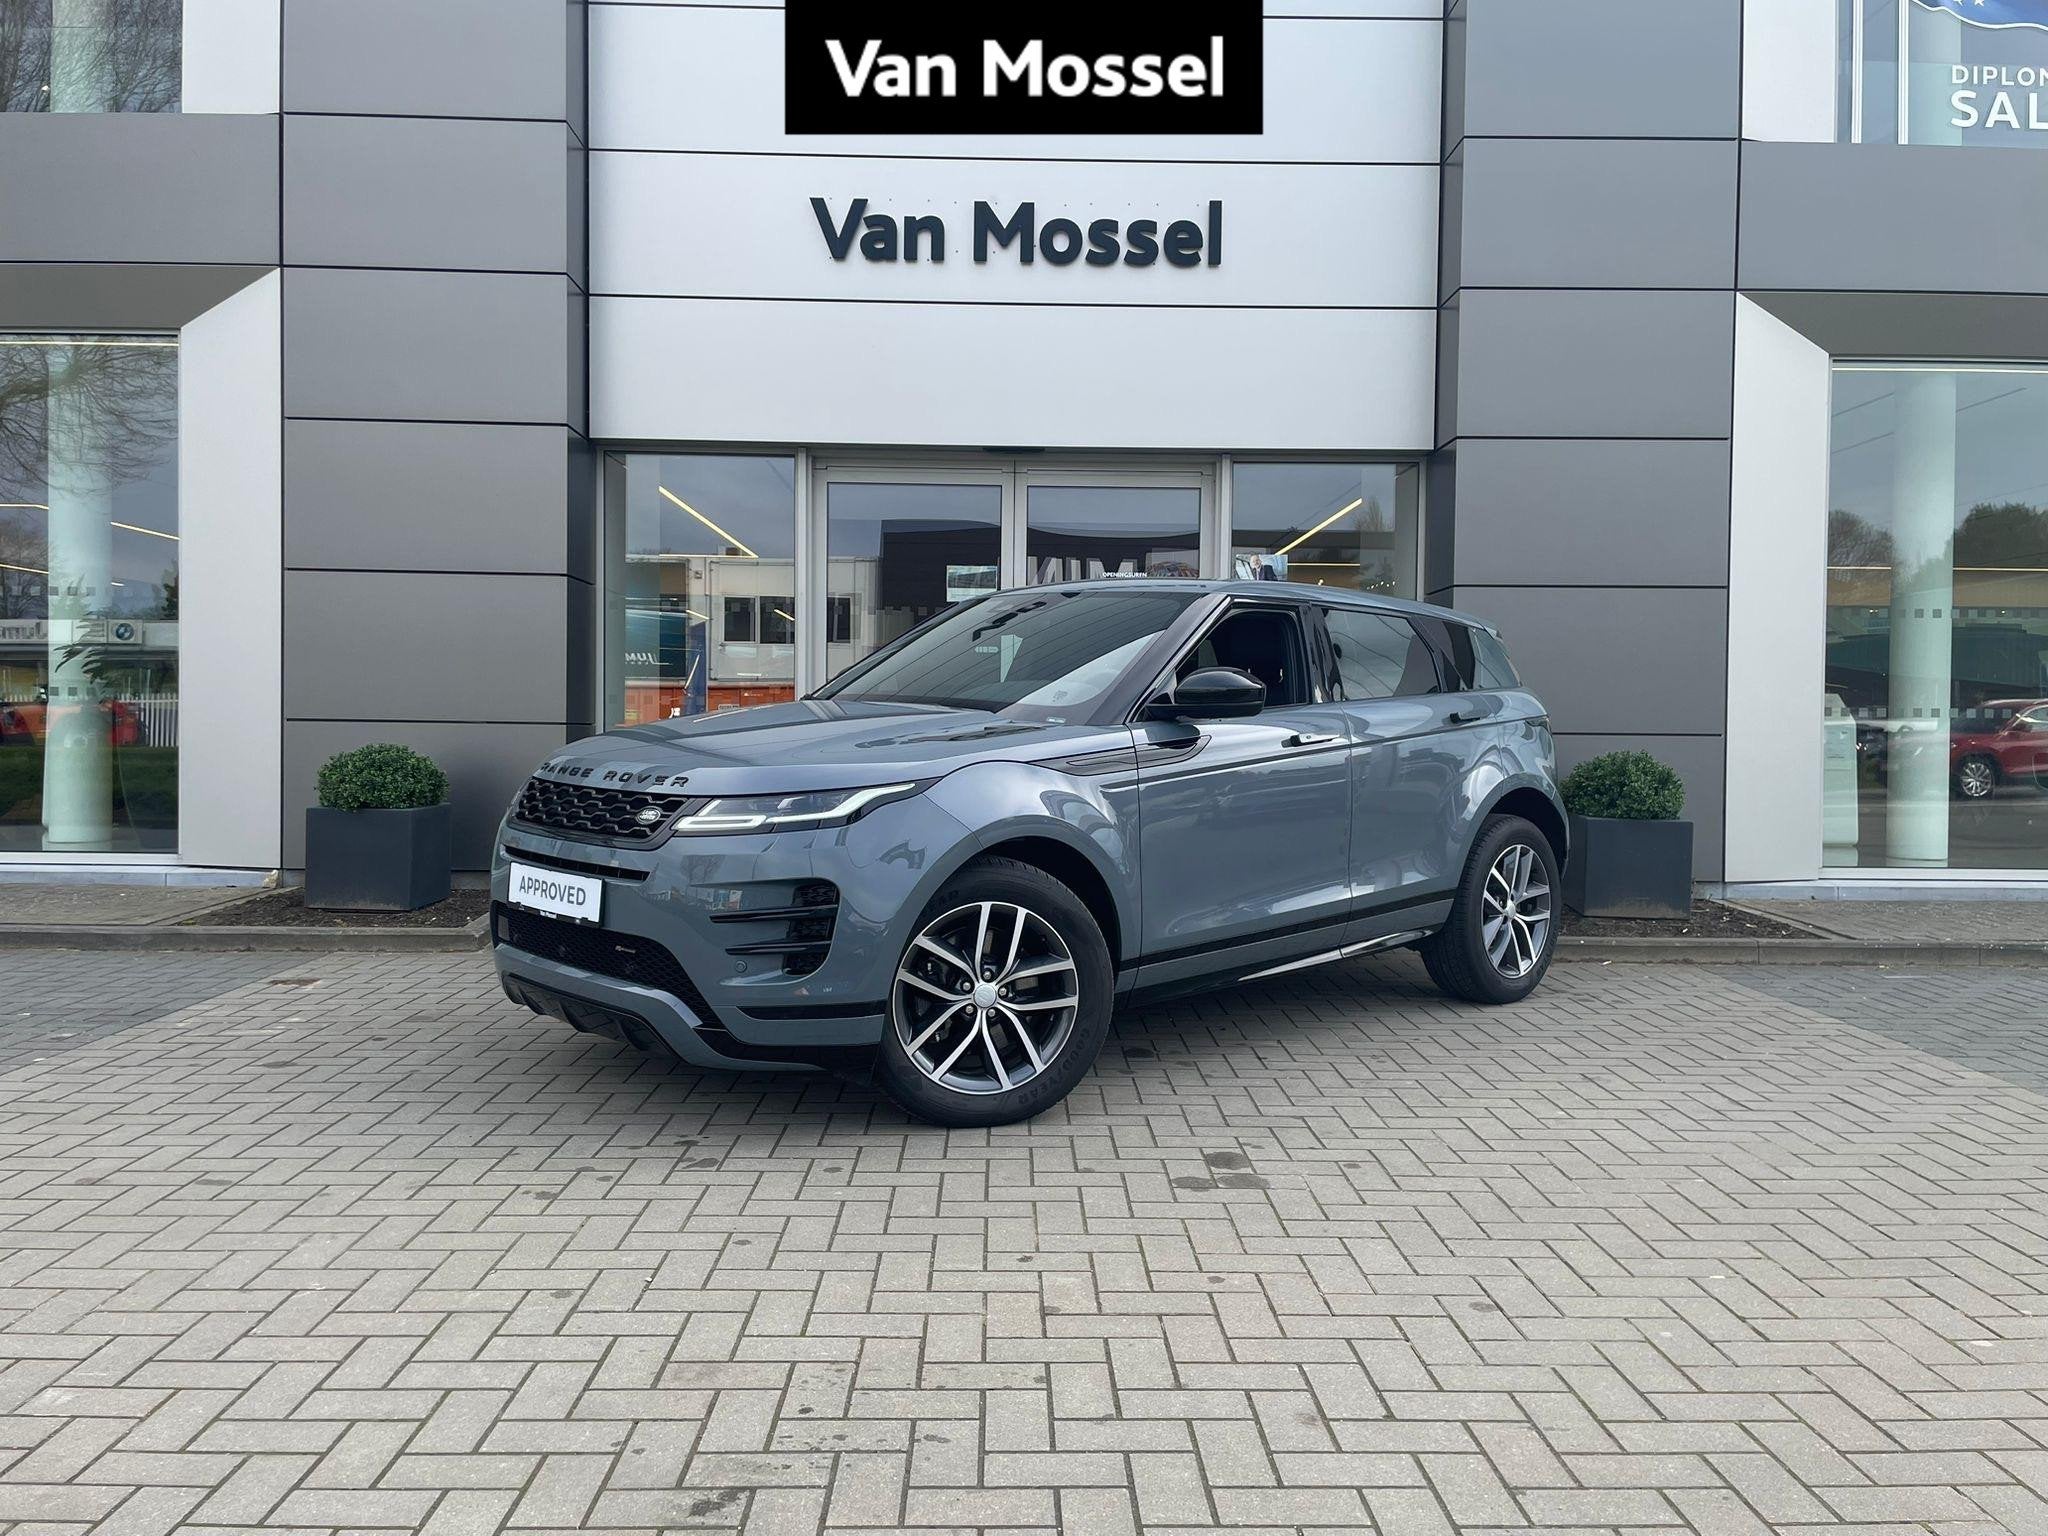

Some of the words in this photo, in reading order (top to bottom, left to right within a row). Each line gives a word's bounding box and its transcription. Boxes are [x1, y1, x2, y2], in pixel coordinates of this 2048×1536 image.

[809, 196, 946, 262] Van
[972, 199, 1223, 268] Mossel
[540, 762, 594, 778] RANGE
[603, 771, 690, 787] ROVER
[519, 875, 587, 906] APPROVED
